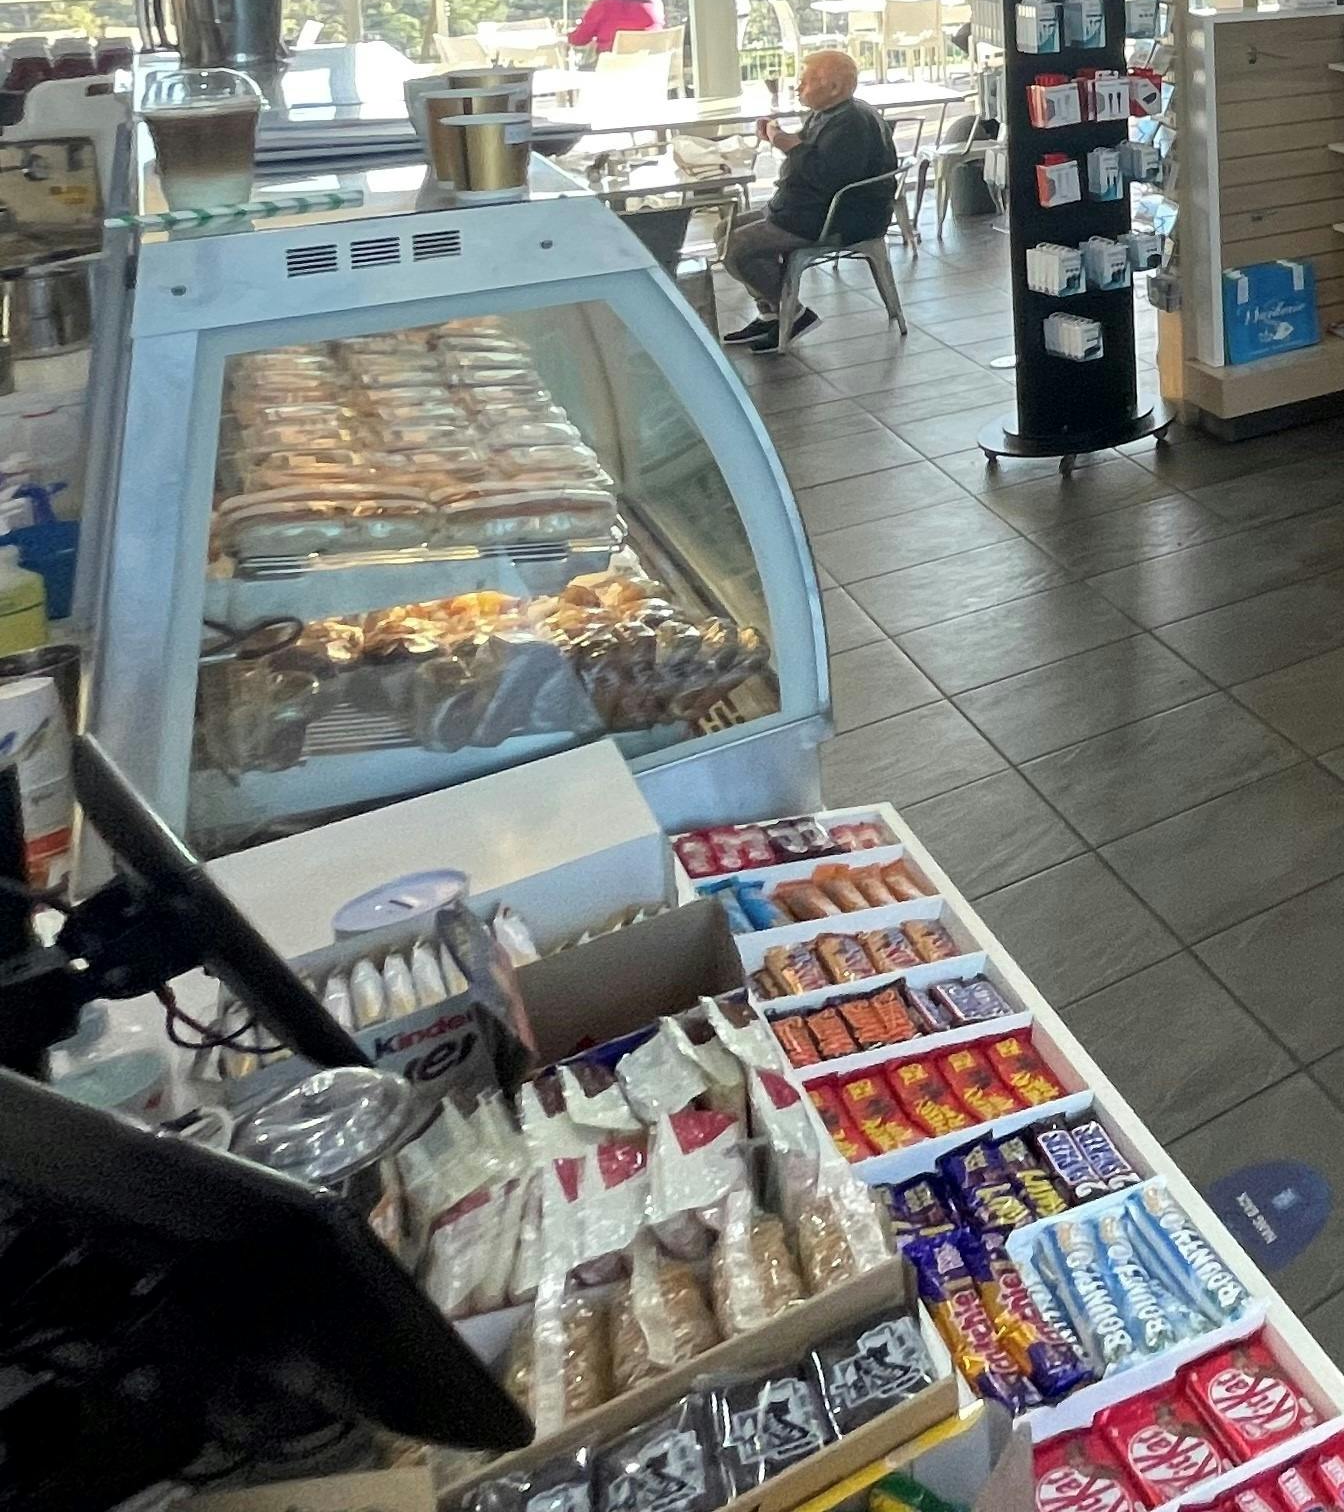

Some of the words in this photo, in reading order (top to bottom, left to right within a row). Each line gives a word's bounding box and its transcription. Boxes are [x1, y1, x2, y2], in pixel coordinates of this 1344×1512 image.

[1072, 1268, 1132, 1354] BOUNTY
[1212, 1369, 1298, 1433] KitKat
[1131, 1428, 1222, 1493] KitKat
